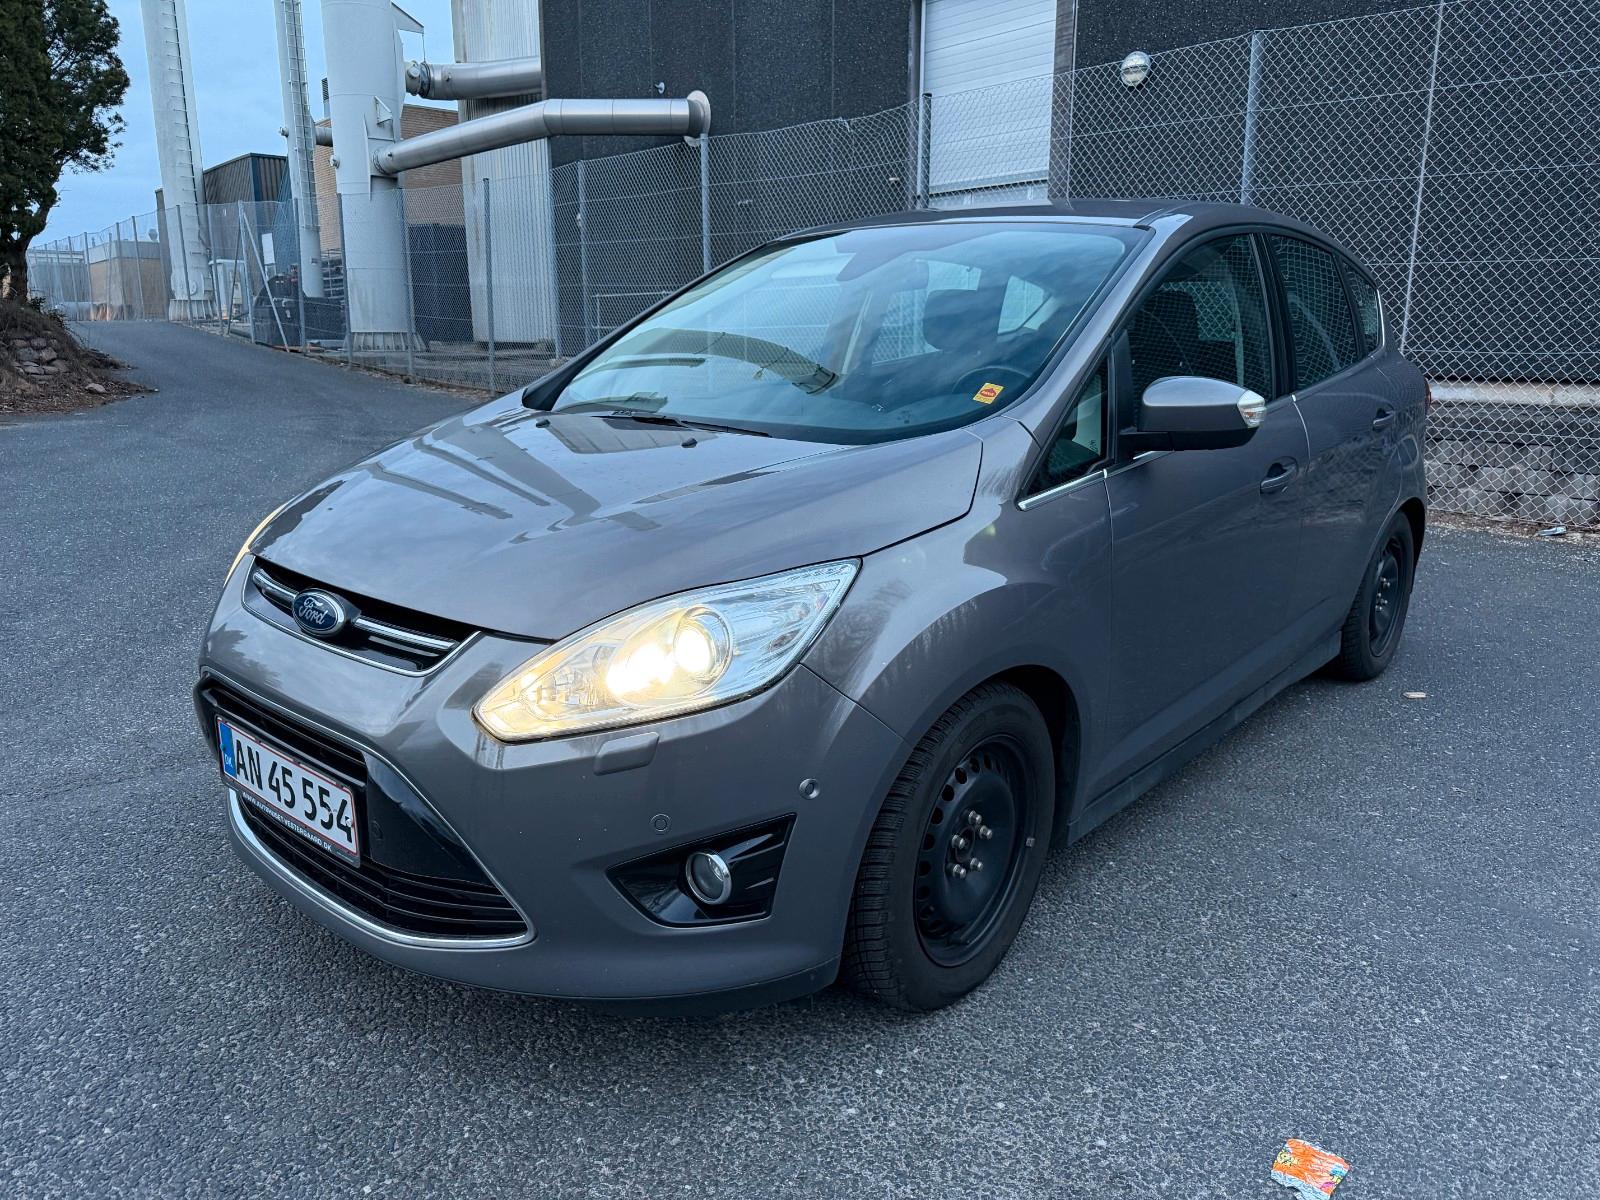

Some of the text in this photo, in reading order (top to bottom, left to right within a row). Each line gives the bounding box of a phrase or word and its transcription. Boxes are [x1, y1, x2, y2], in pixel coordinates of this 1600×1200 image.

[298, 596, 329, 625] Ford
[224, 753, 233, 768] DK
[236, 739, 353, 843] AN 45 554
